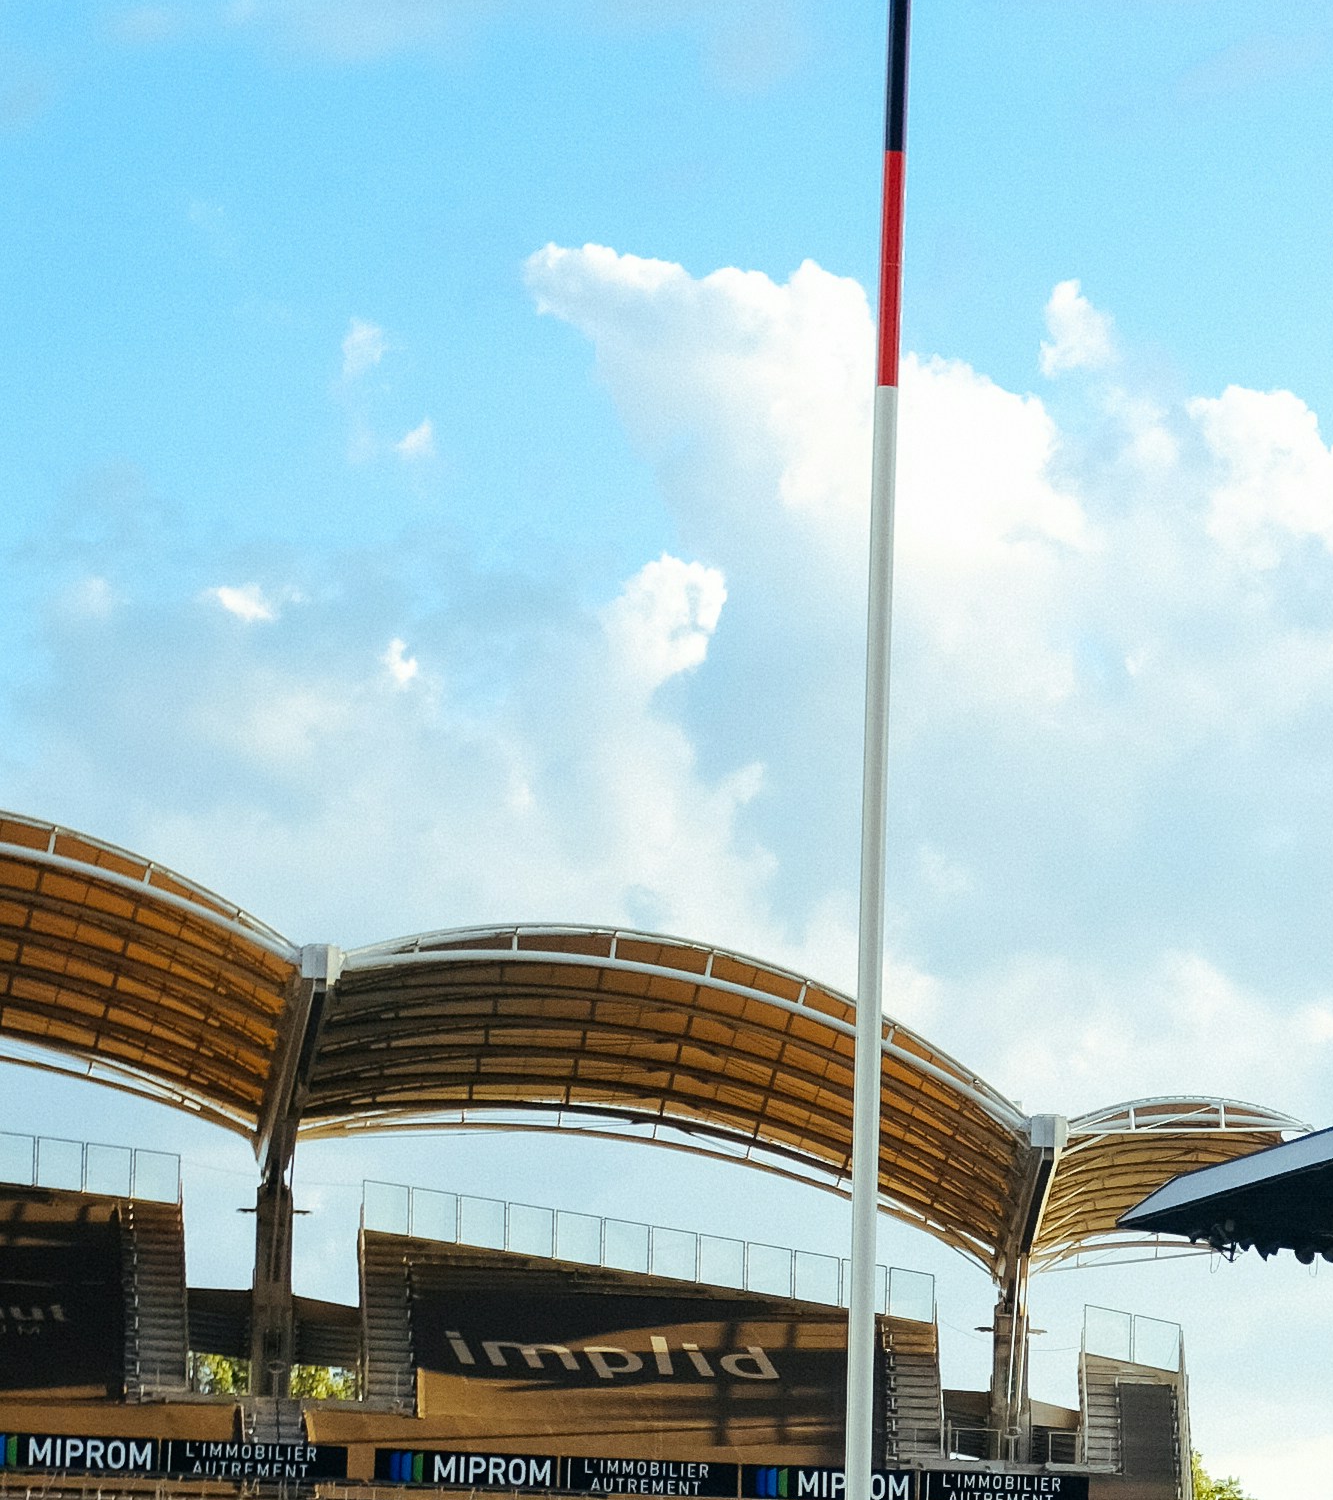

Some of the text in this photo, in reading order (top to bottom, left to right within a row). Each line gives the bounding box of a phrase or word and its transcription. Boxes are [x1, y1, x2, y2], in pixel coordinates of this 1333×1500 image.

[445, 1330, 780, 1380] implid
[28, 1437, 152, 1471] MIPROM
[185, 1442, 317, 1463] L'IMMOBILIER
[192, 1460, 309, 1478] AUTREMENT
[433, 1455, 551, 1487] MIPROM
[584, 1458, 710, 1479] L'IMMOBILIER
[590, 1476, 702, 1497] AUTREMENT
[941, 1473, 1062, 1493] L'IMMOBILIER
